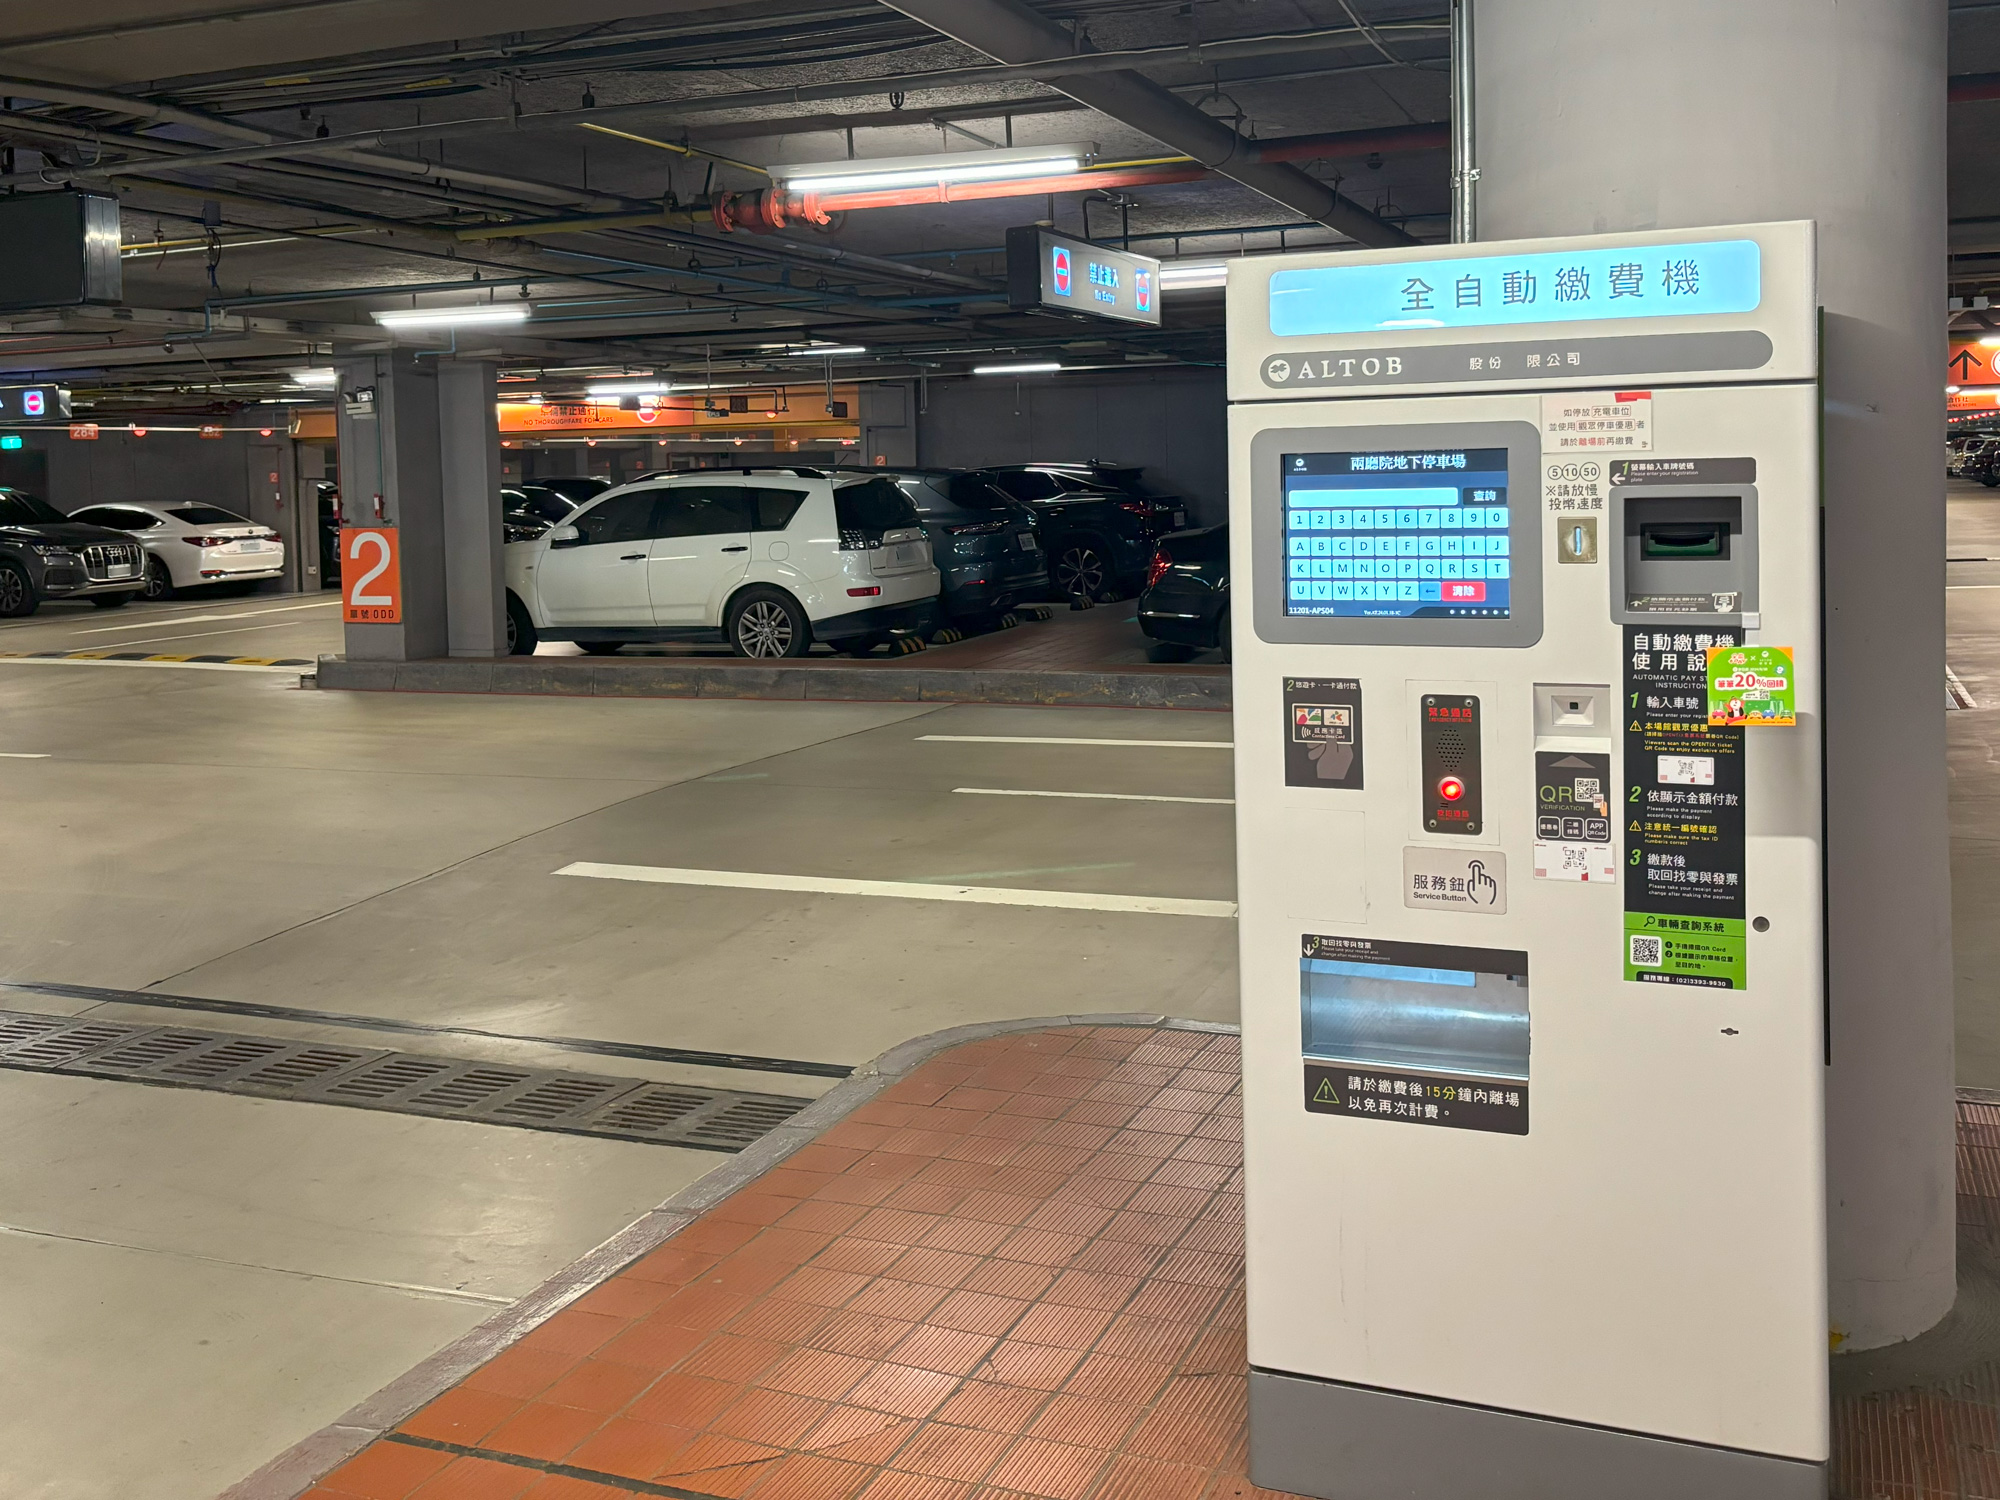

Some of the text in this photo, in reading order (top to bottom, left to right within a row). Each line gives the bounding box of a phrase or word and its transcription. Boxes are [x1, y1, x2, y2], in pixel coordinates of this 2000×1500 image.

[1089, 262, 1119, 288] 禁止進入
[1401, 259, 1700, 311] 全自動繳費機
[1297, 356, 1403, 380] ALTOB
[1469, 352, 1580, 371] 股份 限公司
[1563, 406, 1630, 418] 如停放充電車位
[74, 428, 95, 438] 284
[1560, 436, 1634, 447] 請於離場前再繳費
[876, 456, 884, 465] 2
[1552, 467, 1597, 477] 5 10 50
[1622, 462, 1629, 475] 1
[271, 473, 276, 482] 2
[1549, 497, 1603, 510] 投幣速度
[1297, 513, 1499, 524] 1 2 3 4 5 6 7 8 9 0
[1319, 542, 1324, 550] B
[1339, 542, 1345, 550] C
[1361, 542, 1367, 550] D
[1383, 542, 1388, 550] E
[1405, 542, 1410, 550] F
[1426, 542, 1433, 550] G
[1448, 542, 1455, 550] H
[1495, 541, 1499, 550] J
[350, 532, 392, 605] 2
[1298, 564, 1500, 574] K L M N O P Q R S T
[1298, 586, 1475, 596] U V W X Y Z 清除
[1633, 633, 1735, 651] 自動繳費機
[1632, 653, 1706, 672] 使用說
[1286, 680, 1295, 692] 2
[1630, 692, 1699, 710] 1 輸入車號
[1540, 785, 1573, 803] QR
[1629, 786, 1738, 806] 2 依顯示金額付款
[1540, 804, 1586, 812] VERIFICATION
[1629, 849, 1686, 867] 3 繳款後
[1413, 874, 1465, 892] 服務鈕
[1647, 869, 1738, 886] 取回找零與發票
[1413, 892, 1467, 902] Service Button
[1657, 918, 1725, 932] 車輛查詢系統
[1312, 937, 1320, 948] 3
[1348, 1075, 1520, 1107] 請於繳費後15分鐘內離場
[1348, 1096, 1450, 1120] 以免再次計費。
